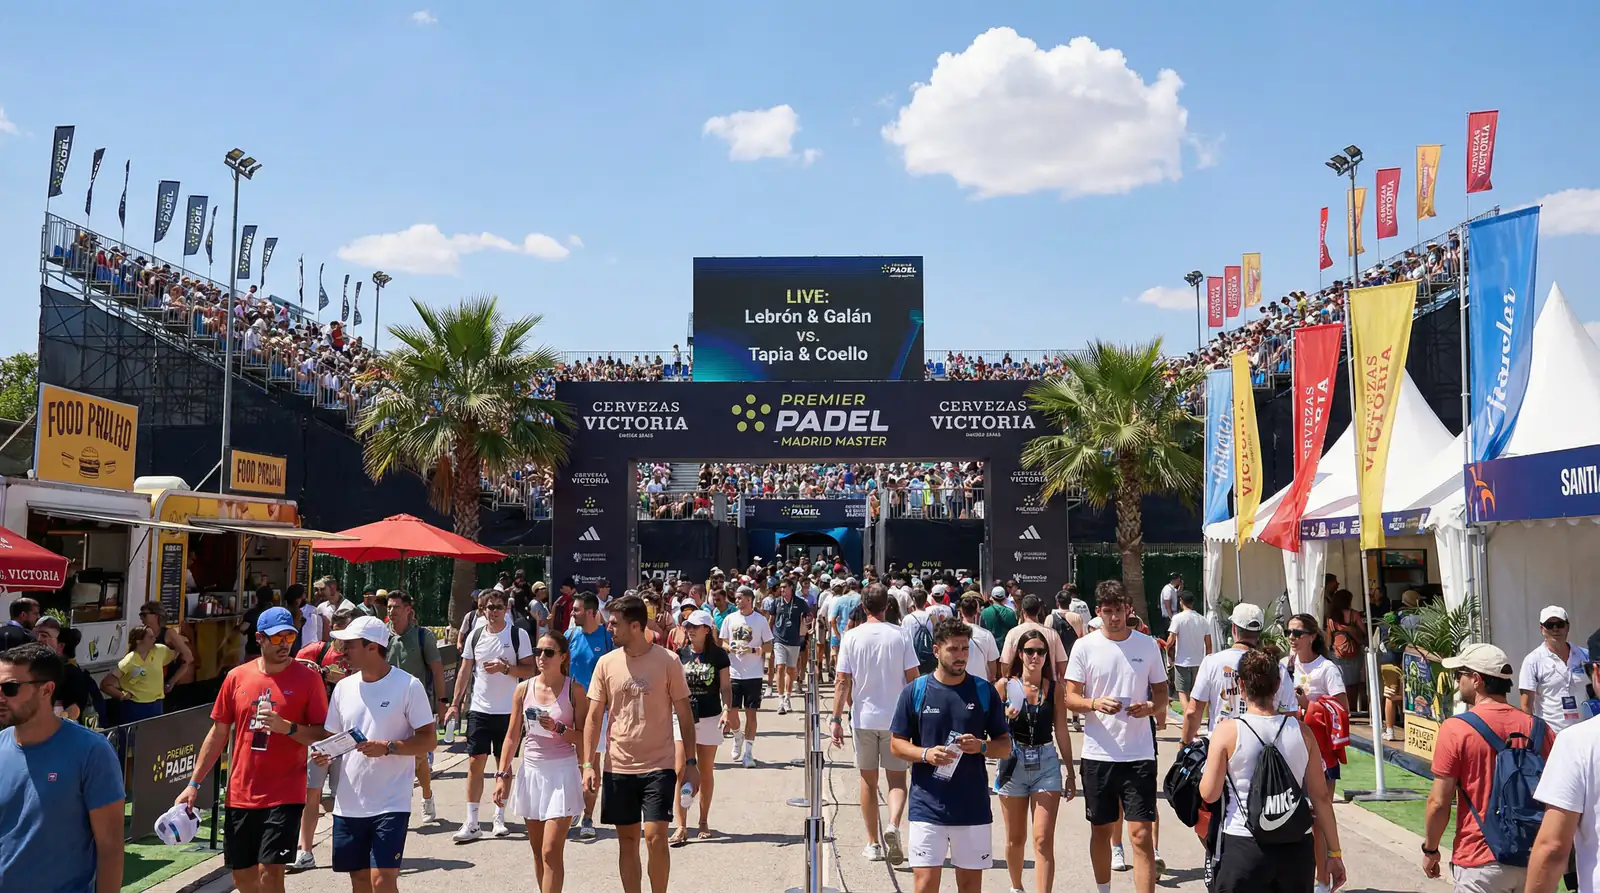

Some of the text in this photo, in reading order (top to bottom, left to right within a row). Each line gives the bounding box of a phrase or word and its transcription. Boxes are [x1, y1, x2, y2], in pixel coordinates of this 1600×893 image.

[59, 136, 70, 174] PADEL
[1478, 124, 1490, 177] VICTORIA
[786, 289, 829, 304] LIVE:
[745, 308, 872, 324] Lebrón & Galán
[796, 331, 820, 342] vs.
[748, 346, 868, 365] Tapia & Coello
[592, 401, 680, 412] CERVEZAS
[781, 394, 866, 406] PREMIER
[939, 400, 1027, 412] CERVEZAS
[48, 400, 84, 438] FOOD
[583, 416, 689, 430] VICTORIA
[775, 410, 889, 432] PADEL
[930, 415, 1036, 430] VICTORIA
[781, 436, 832, 446] MADRID
[836, 436, 887, 446] MASTER
[237, 458, 256, 483] FOOD
[1561, 465, 1600, 496] SANTI
[8, 569, 60, 581] VICTORIA
[1264, 787, 1297, 815] NIKE
